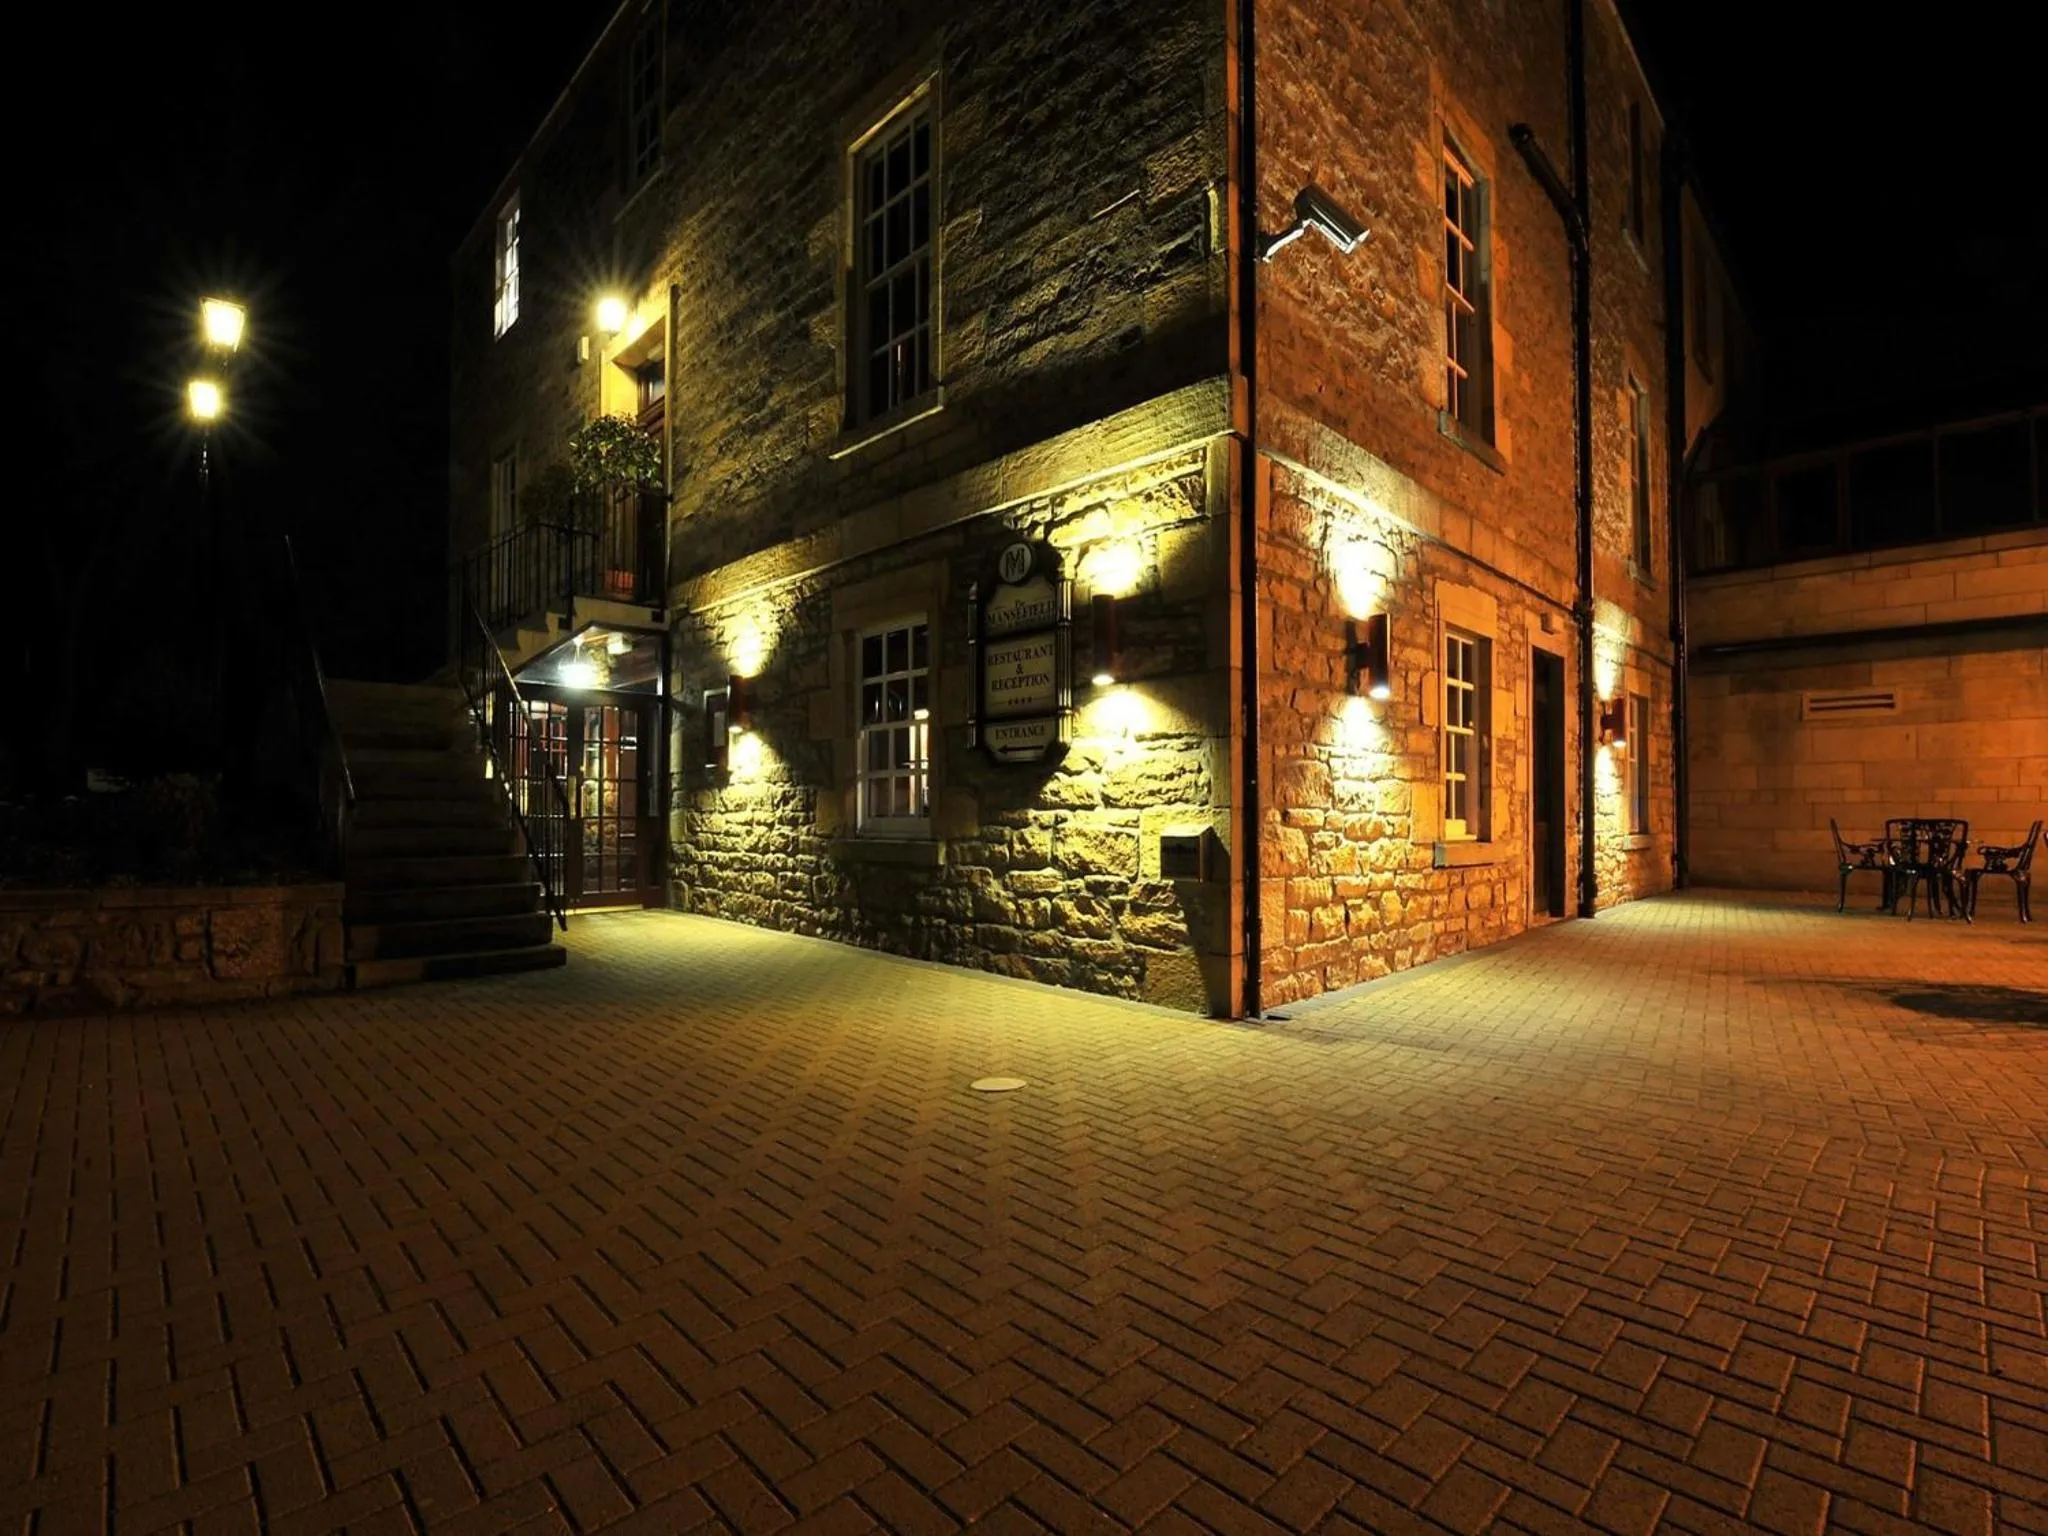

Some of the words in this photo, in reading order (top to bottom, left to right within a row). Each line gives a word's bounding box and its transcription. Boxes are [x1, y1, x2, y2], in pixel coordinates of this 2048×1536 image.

[988, 644, 1054, 666] RESTAURANT
[1015, 664, 1024, 674] &
[991, 673, 1049, 690] RECEPTION
[995, 725, 1045, 740] ENTRANCE
